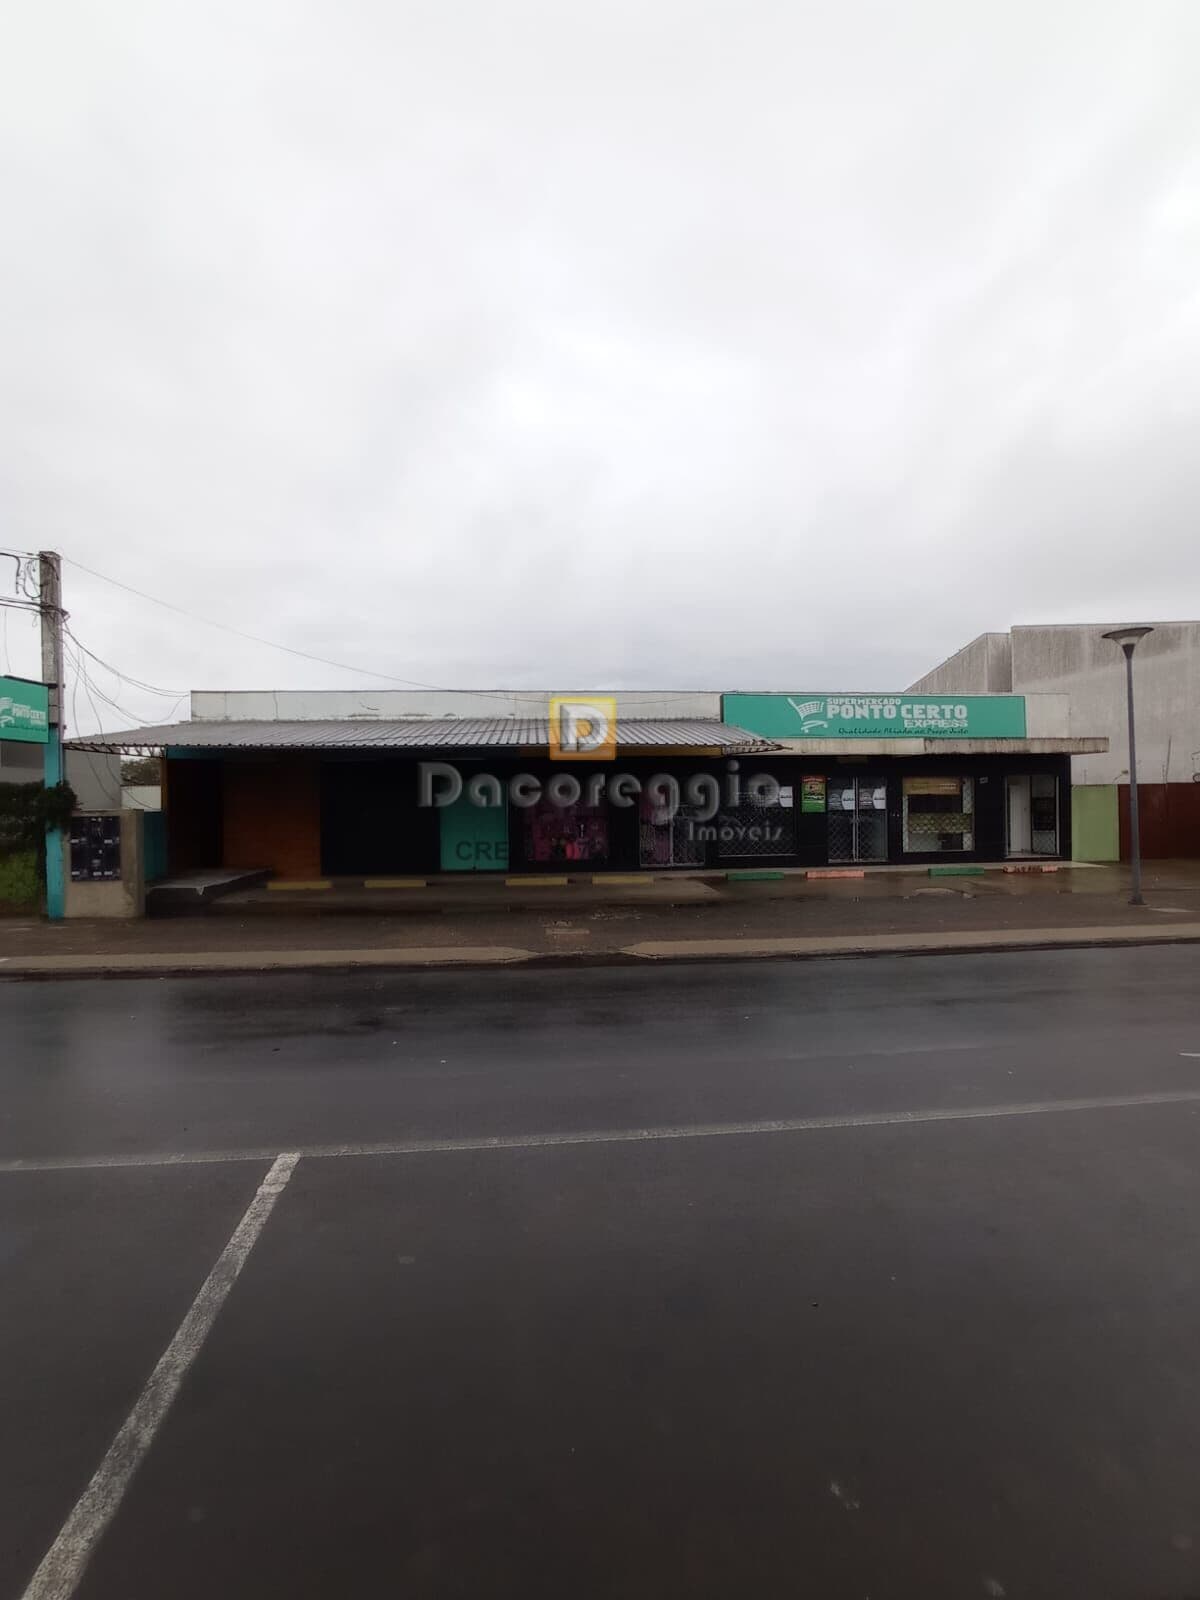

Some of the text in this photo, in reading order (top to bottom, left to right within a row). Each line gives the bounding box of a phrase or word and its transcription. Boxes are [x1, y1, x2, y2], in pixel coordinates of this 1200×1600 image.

[827, 697, 902, 705] SUPERMERCADO
[827, 704, 967, 719] PONTO CERTO
[904, 719, 968, 728] EXPRESS
